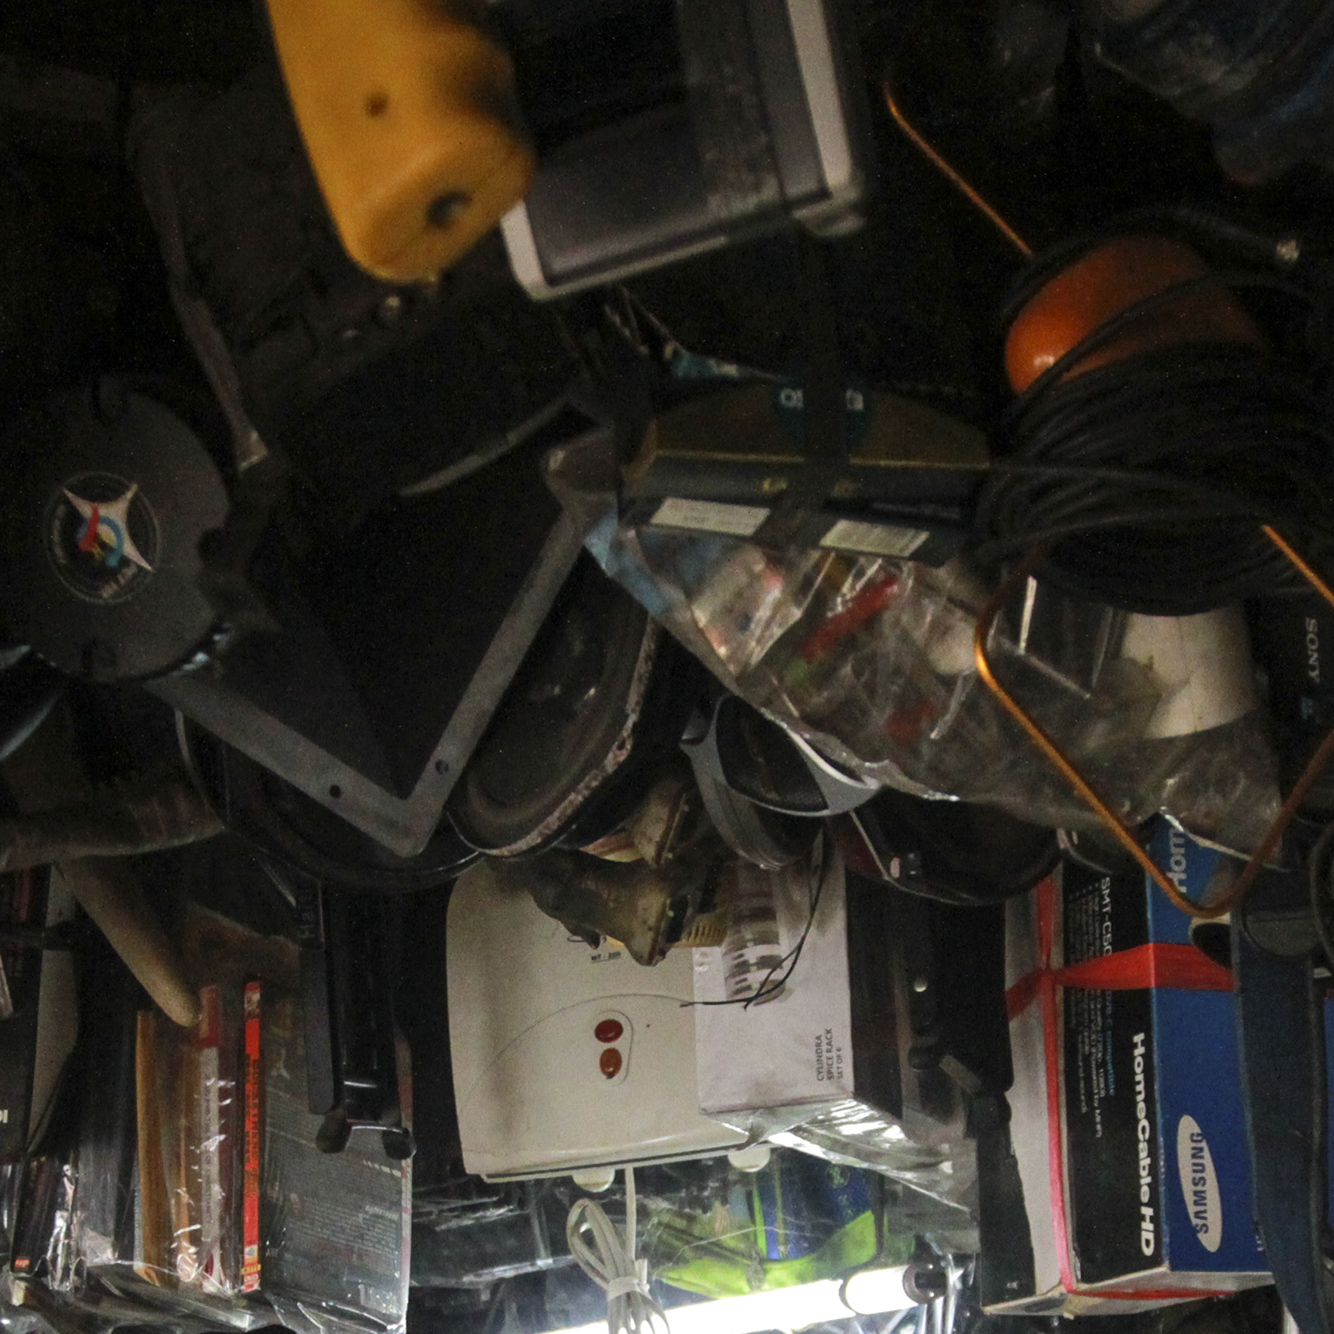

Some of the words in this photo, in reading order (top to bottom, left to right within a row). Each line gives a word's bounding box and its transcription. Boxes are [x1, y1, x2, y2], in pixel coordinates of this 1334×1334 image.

[1305, 617, 1320, 683] SONY
[814, 1034, 825, 1082] CYLINDRA
[824, 1028, 834, 1054] RACK
[1105, 1030, 1116, 1097] compatible
[825, 1055, 835, 1080] SPICE
[1190, 1131, 1210, 1235] SAMSUNG
[1140, 1206, 1156, 1257] HD
